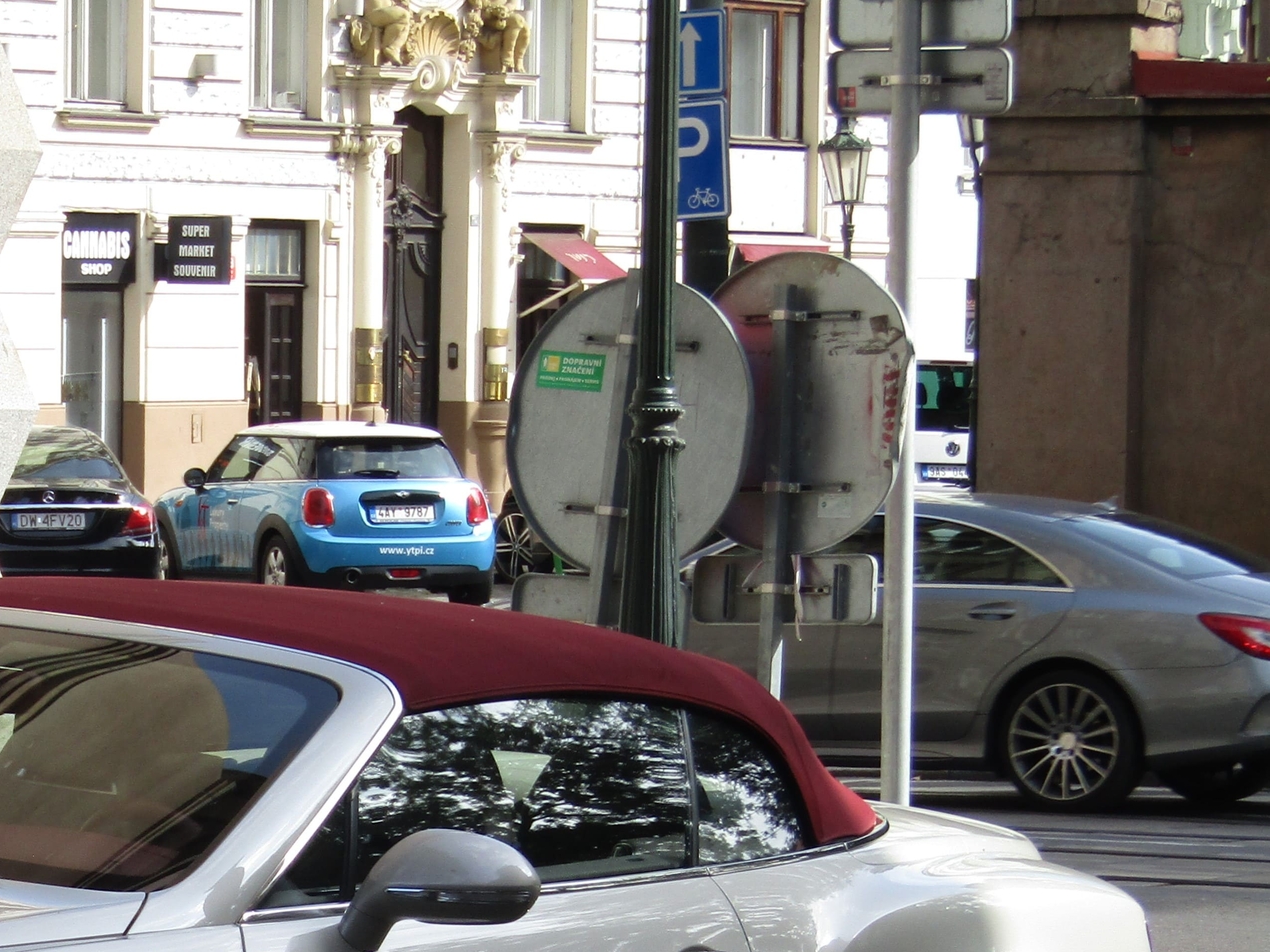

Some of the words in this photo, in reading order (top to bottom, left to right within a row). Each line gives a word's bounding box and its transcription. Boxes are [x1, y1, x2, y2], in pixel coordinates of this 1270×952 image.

[678, 117, 710, 183] P
[181, 225, 210, 238] SUPER
[63, 230, 131, 259] CANNABIS
[179, 245, 215, 258] MARKET
[80, 263, 113, 275] SHOP
[173, 264, 216, 278] SOUVENIR
[562, 357, 603, 367] DOPRAVNÍ
[378, 507, 396, 517] 4AY
[404, 507, 429, 517] 9787
[20, 514, 37, 527] DW
[42, 514, 82, 527] 4FV20
